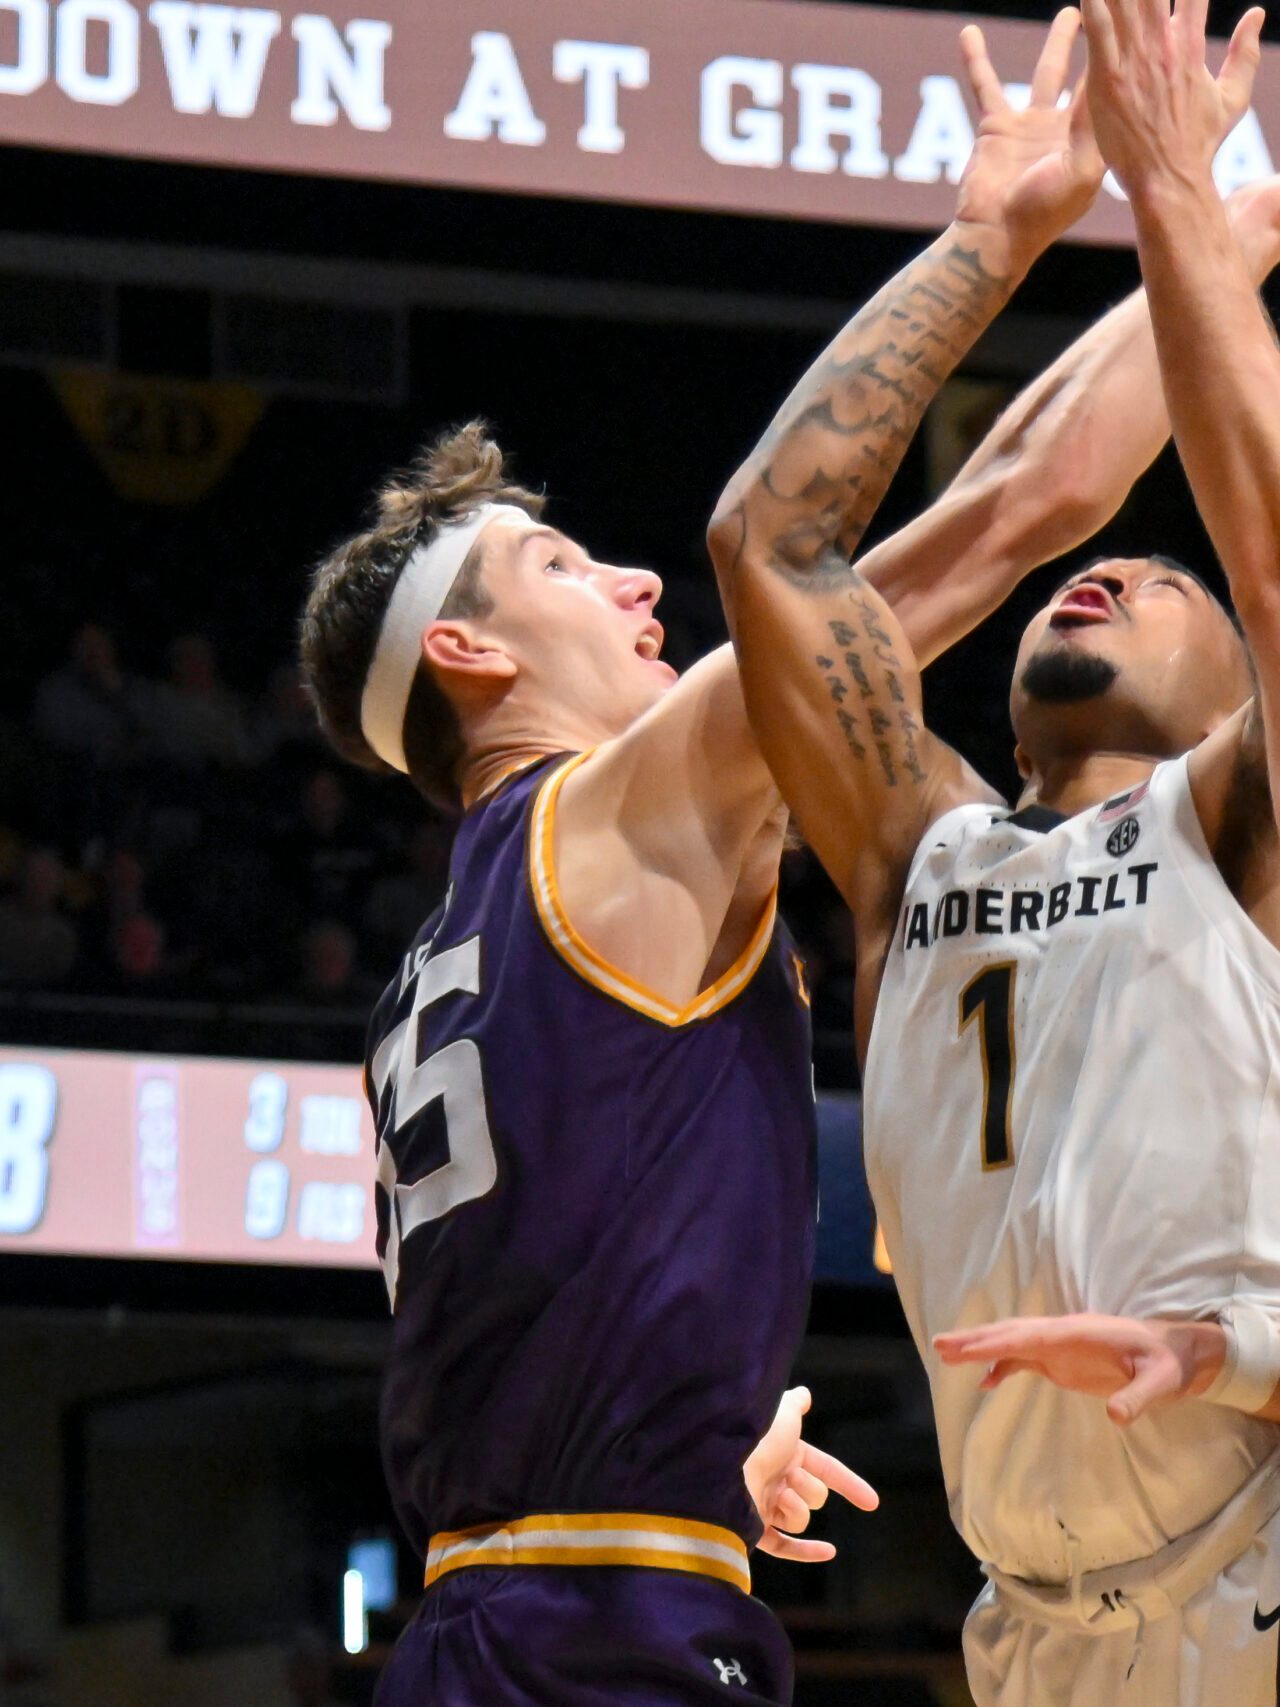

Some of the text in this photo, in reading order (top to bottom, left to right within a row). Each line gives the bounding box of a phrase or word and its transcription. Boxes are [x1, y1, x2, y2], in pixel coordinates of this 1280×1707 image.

[444, 32, 649, 153] AT
[1109, 819, 1139, 855] SEC
[902, 862, 1158, 949] ADERBILT
[957, 960, 1018, 1173] 1
